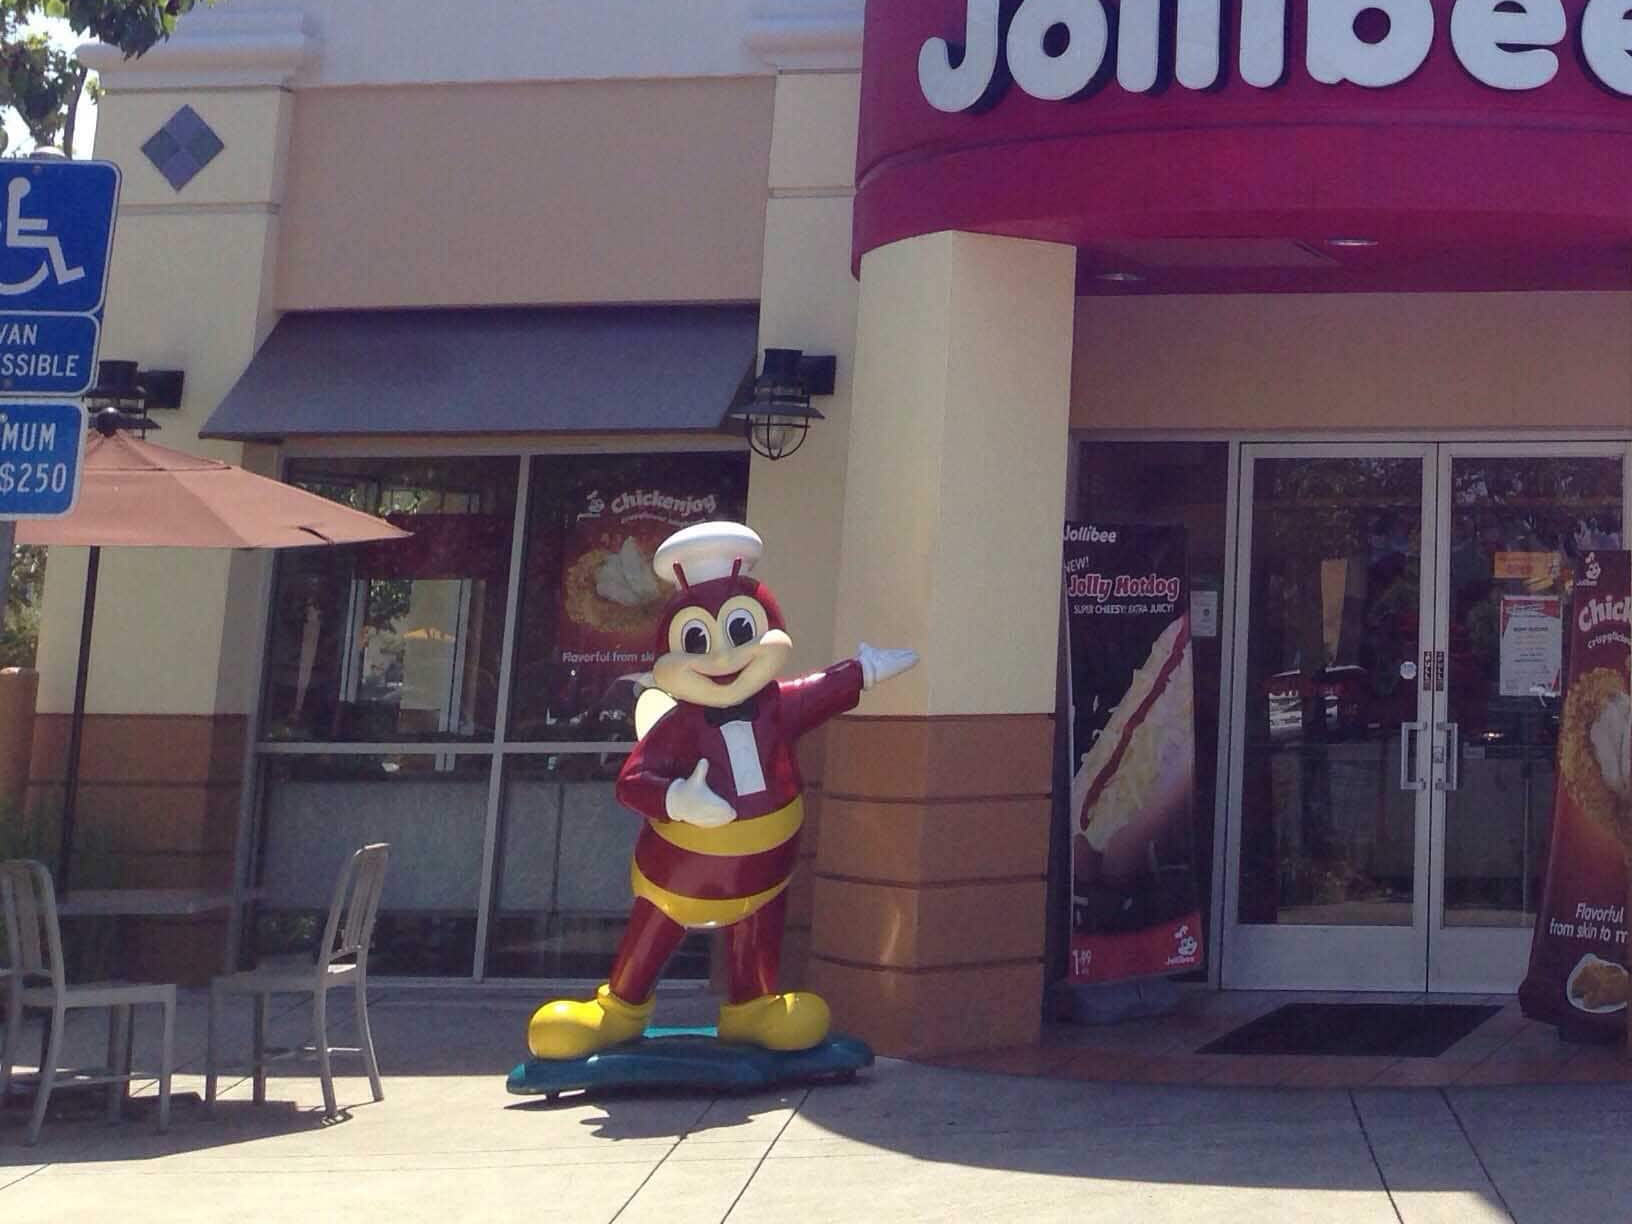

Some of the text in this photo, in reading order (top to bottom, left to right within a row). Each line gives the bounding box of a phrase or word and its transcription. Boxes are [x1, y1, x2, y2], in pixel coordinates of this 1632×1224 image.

[0, 354, 80, 377] SSIBLE
[1, 422, 56, 452] MUM
[0, 461, 67, 496] $250
[1063, 525, 1117, 543] Jollibee
[1069, 573, 1180, 603] Jolly Hotdog
[562, 652, 610, 663] Flavorful
[612, 652, 638, 663] from
[1575, 902, 1625, 924] Flavorful
[1550, 918, 1575, 937] from
[1576, 922, 1598, 939] skin
[1599, 924, 1612, 942] to
